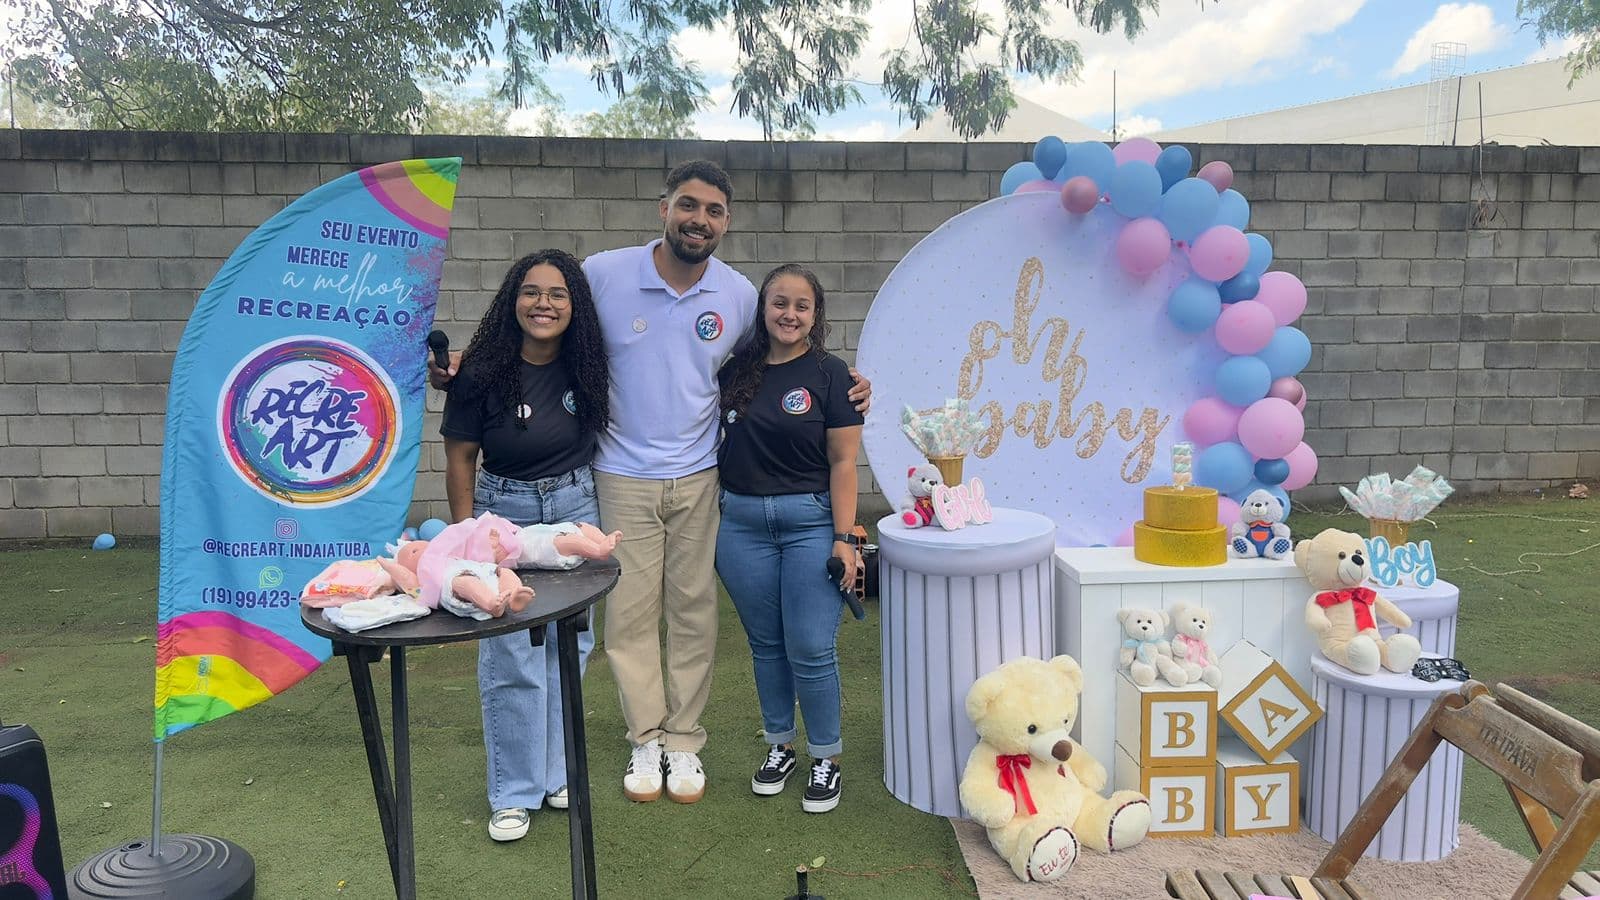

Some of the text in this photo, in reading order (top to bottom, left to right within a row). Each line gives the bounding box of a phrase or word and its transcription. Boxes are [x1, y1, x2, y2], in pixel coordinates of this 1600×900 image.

[321, 220, 419, 249] SEU EVENTO
[282, 252, 413, 305] a melhor
[287, 246, 349, 269] MERECE
[238, 297, 411, 329] RECREAÇÃO
[969, 256, 1070, 383] oh
[251, 379, 368, 430] RECRE
[261, 418, 359, 475] ART
[203, 538, 371, 558] @RECREART.INDAIATUBA
[1363, 536, 1436, 588] Boy
[202, 587, 232, 604] (19)
[1162, 697, 1298, 748] B A
[1161, 783, 1282, 823] B Y
